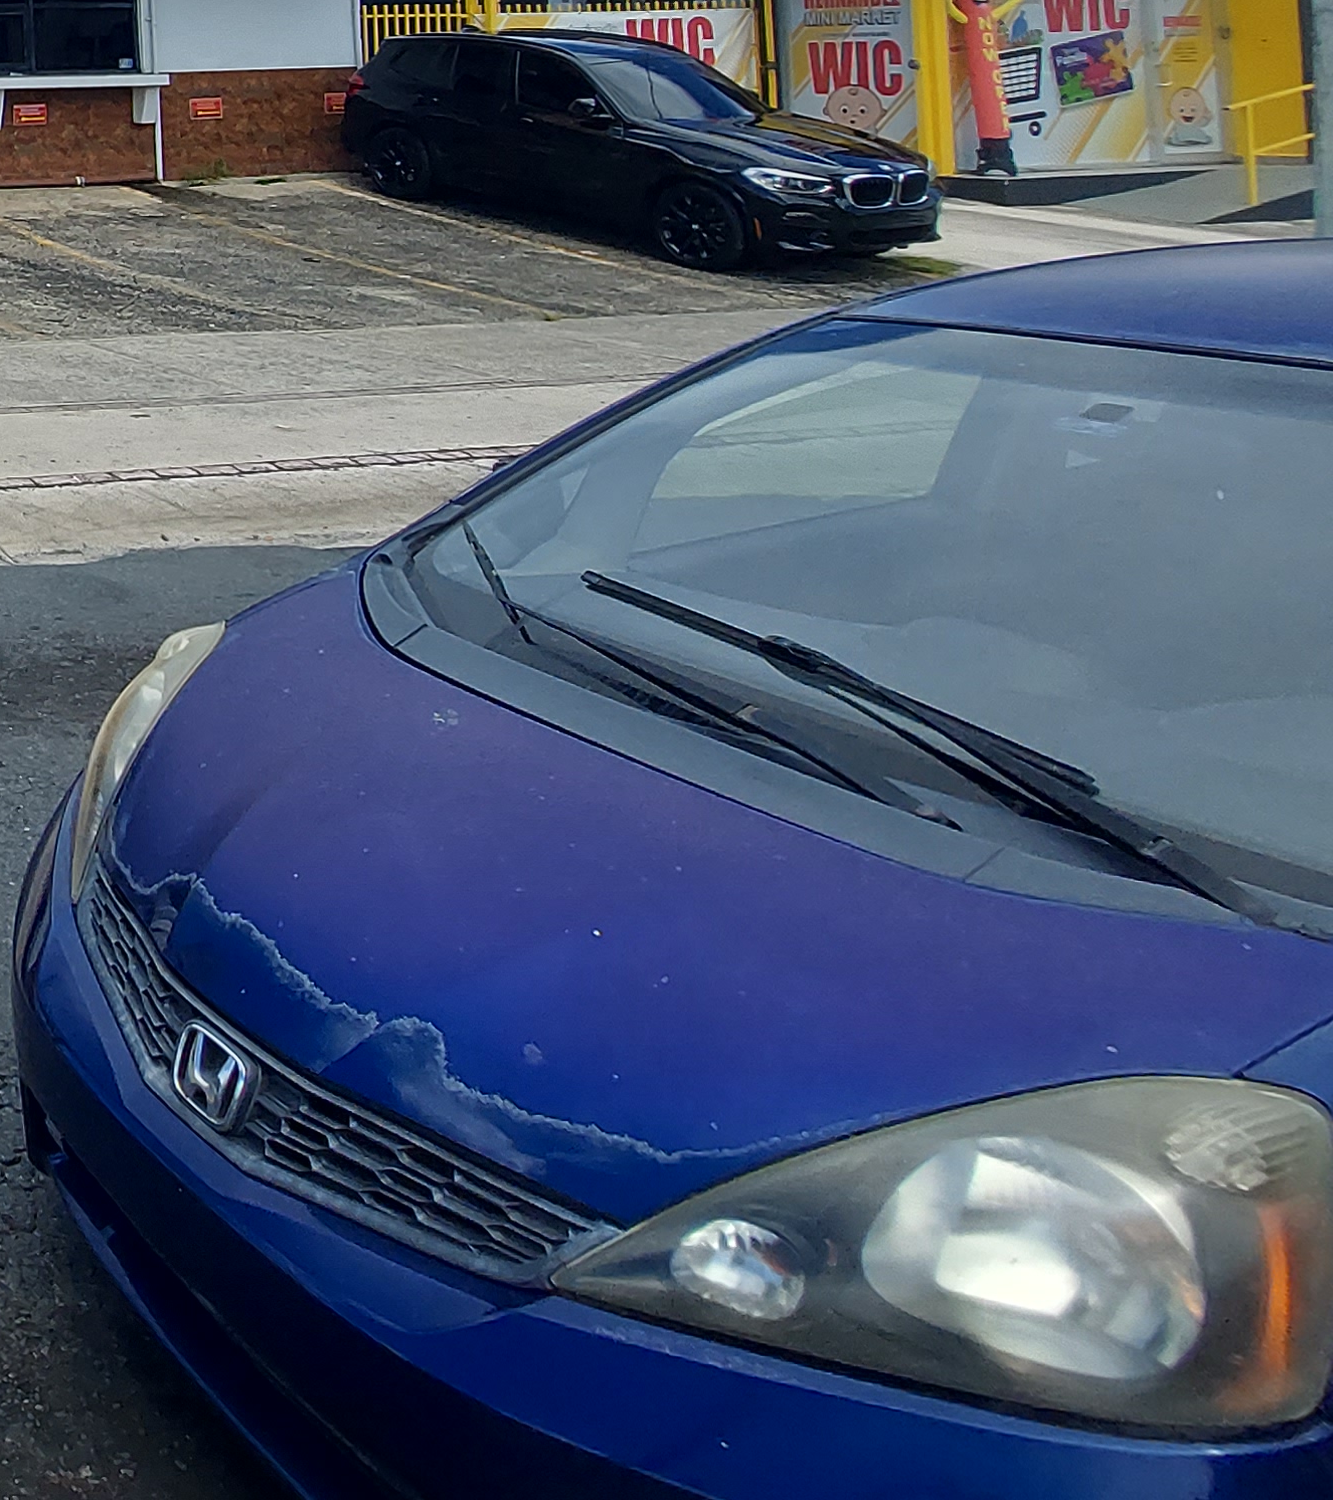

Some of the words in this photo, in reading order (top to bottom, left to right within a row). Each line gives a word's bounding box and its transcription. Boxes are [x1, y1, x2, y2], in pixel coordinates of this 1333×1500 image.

[804, 11, 835, 27] MINI
[837, 10, 901, 26] MARKET
[978, 16, 999, 62] NOW
[808, 39, 904, 97] WIC
